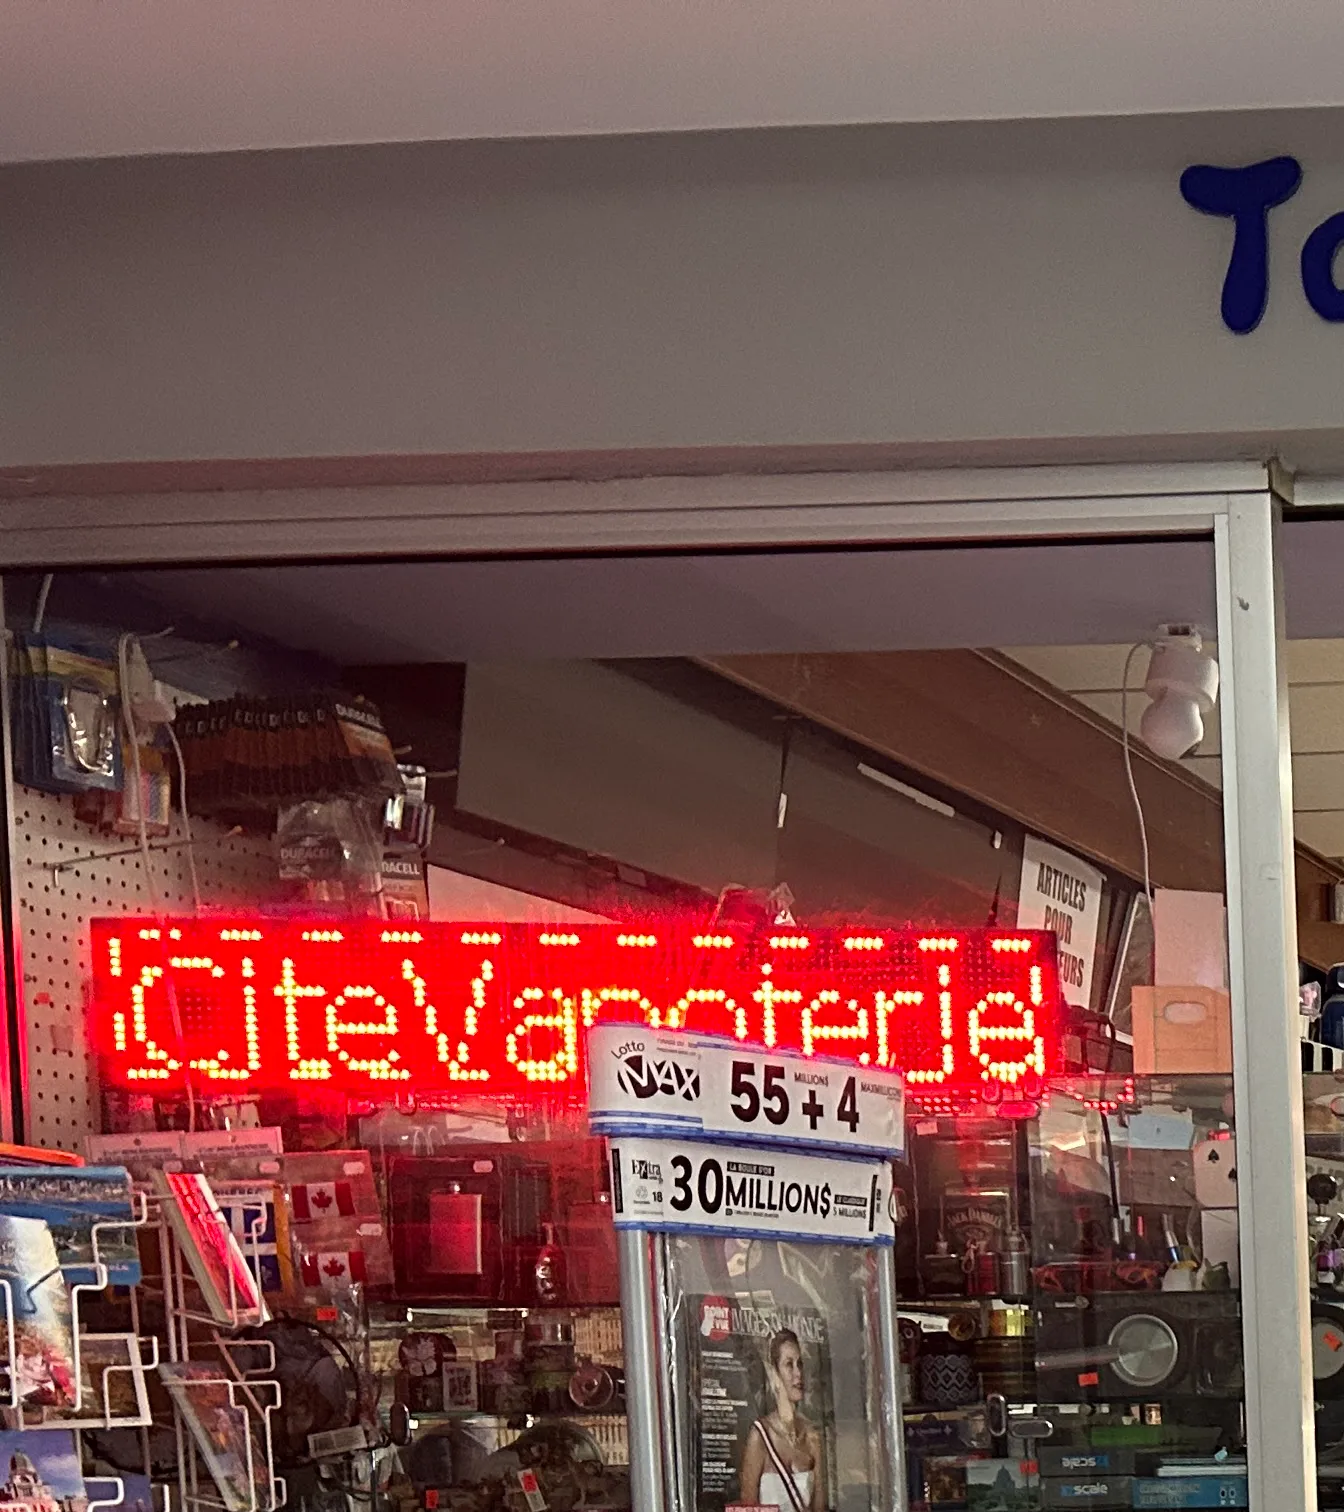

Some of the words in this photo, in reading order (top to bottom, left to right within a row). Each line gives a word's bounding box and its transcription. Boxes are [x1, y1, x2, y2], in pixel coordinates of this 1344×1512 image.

[1037, 862, 1086, 912] ARTICLES
[1044, 905, 1073, 944] POUR
[611, 1041, 645, 1060] Lotto
[617, 1054, 700, 1101] MAX
[730, 1060, 789, 1125] 55
[837, 1076, 860, 1133] 4
[652, 1191, 663, 1202] 18
[670, 1155, 724, 1214] 30
[726, 1175, 830, 1217] MILLION$
[1073, 1482, 1108, 1496] scale
